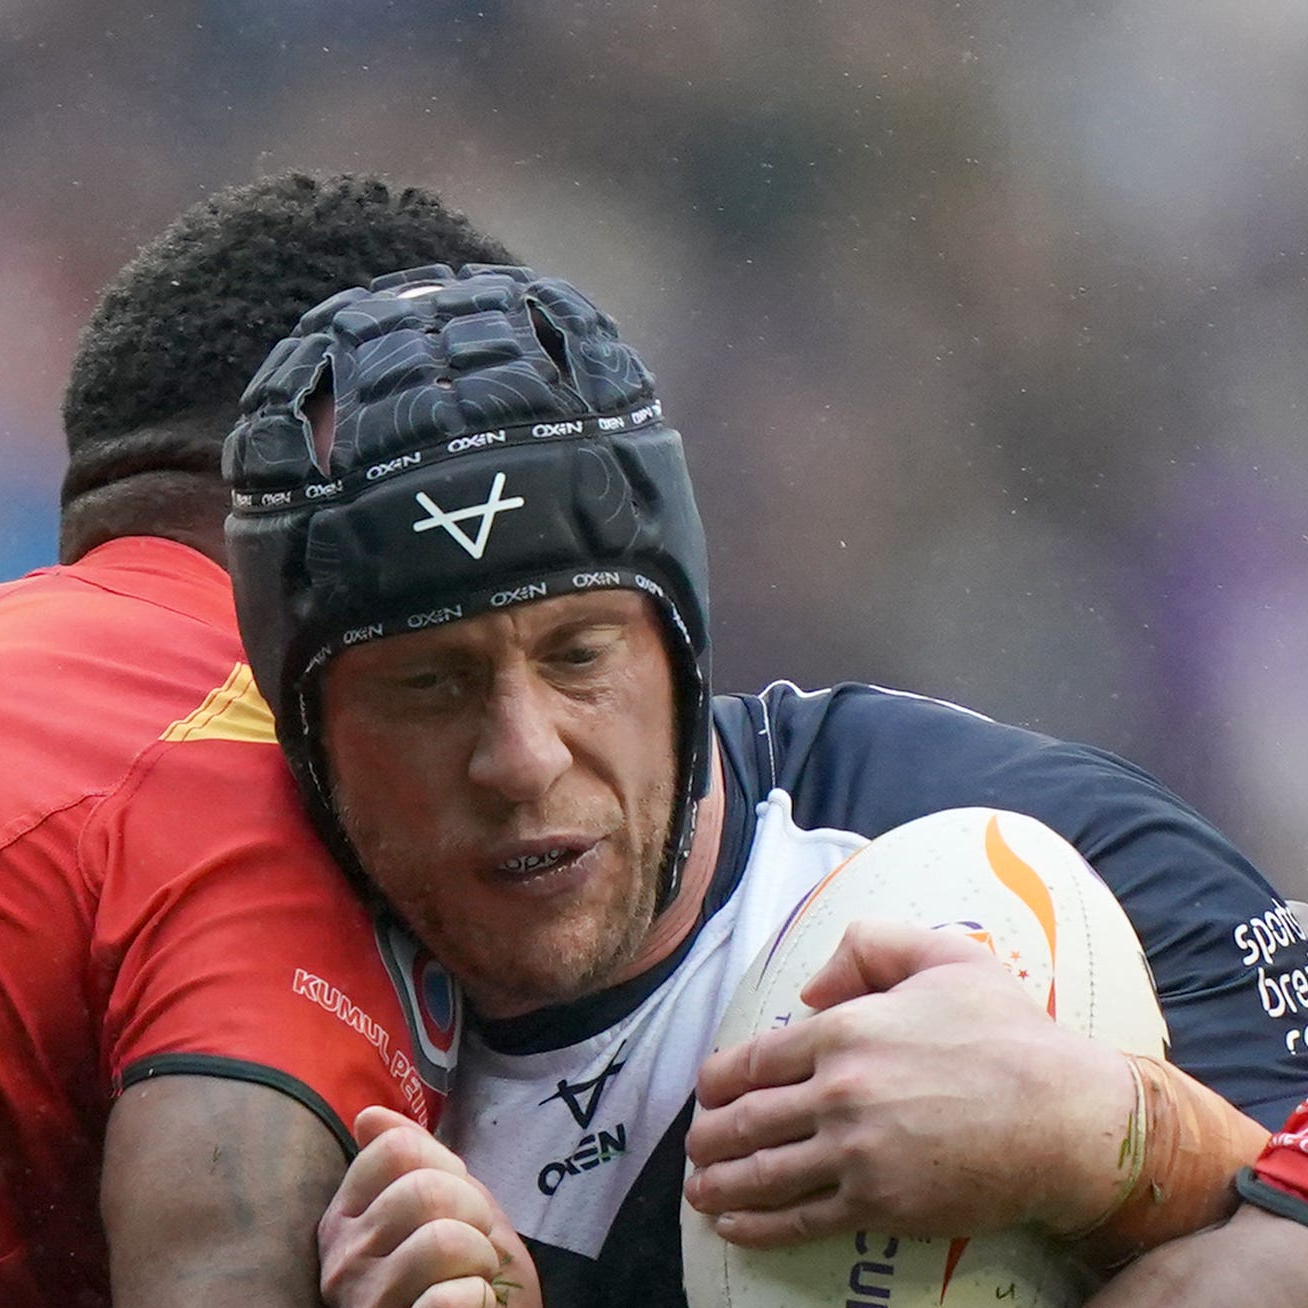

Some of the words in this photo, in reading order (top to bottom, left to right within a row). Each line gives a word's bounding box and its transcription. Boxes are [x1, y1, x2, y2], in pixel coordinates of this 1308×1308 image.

[366, 452, 422, 480] OXEN
[447, 430, 506, 453] OXEN
[532, 420, 584, 438] OXEN
[343, 623, 383, 644] OXEN
[407, 604, 463, 628] OXEN
[491, 582, 547, 606] OXEN
[572, 571, 620, 588] OXEN
[293, 967, 391, 1064] KUMUL
